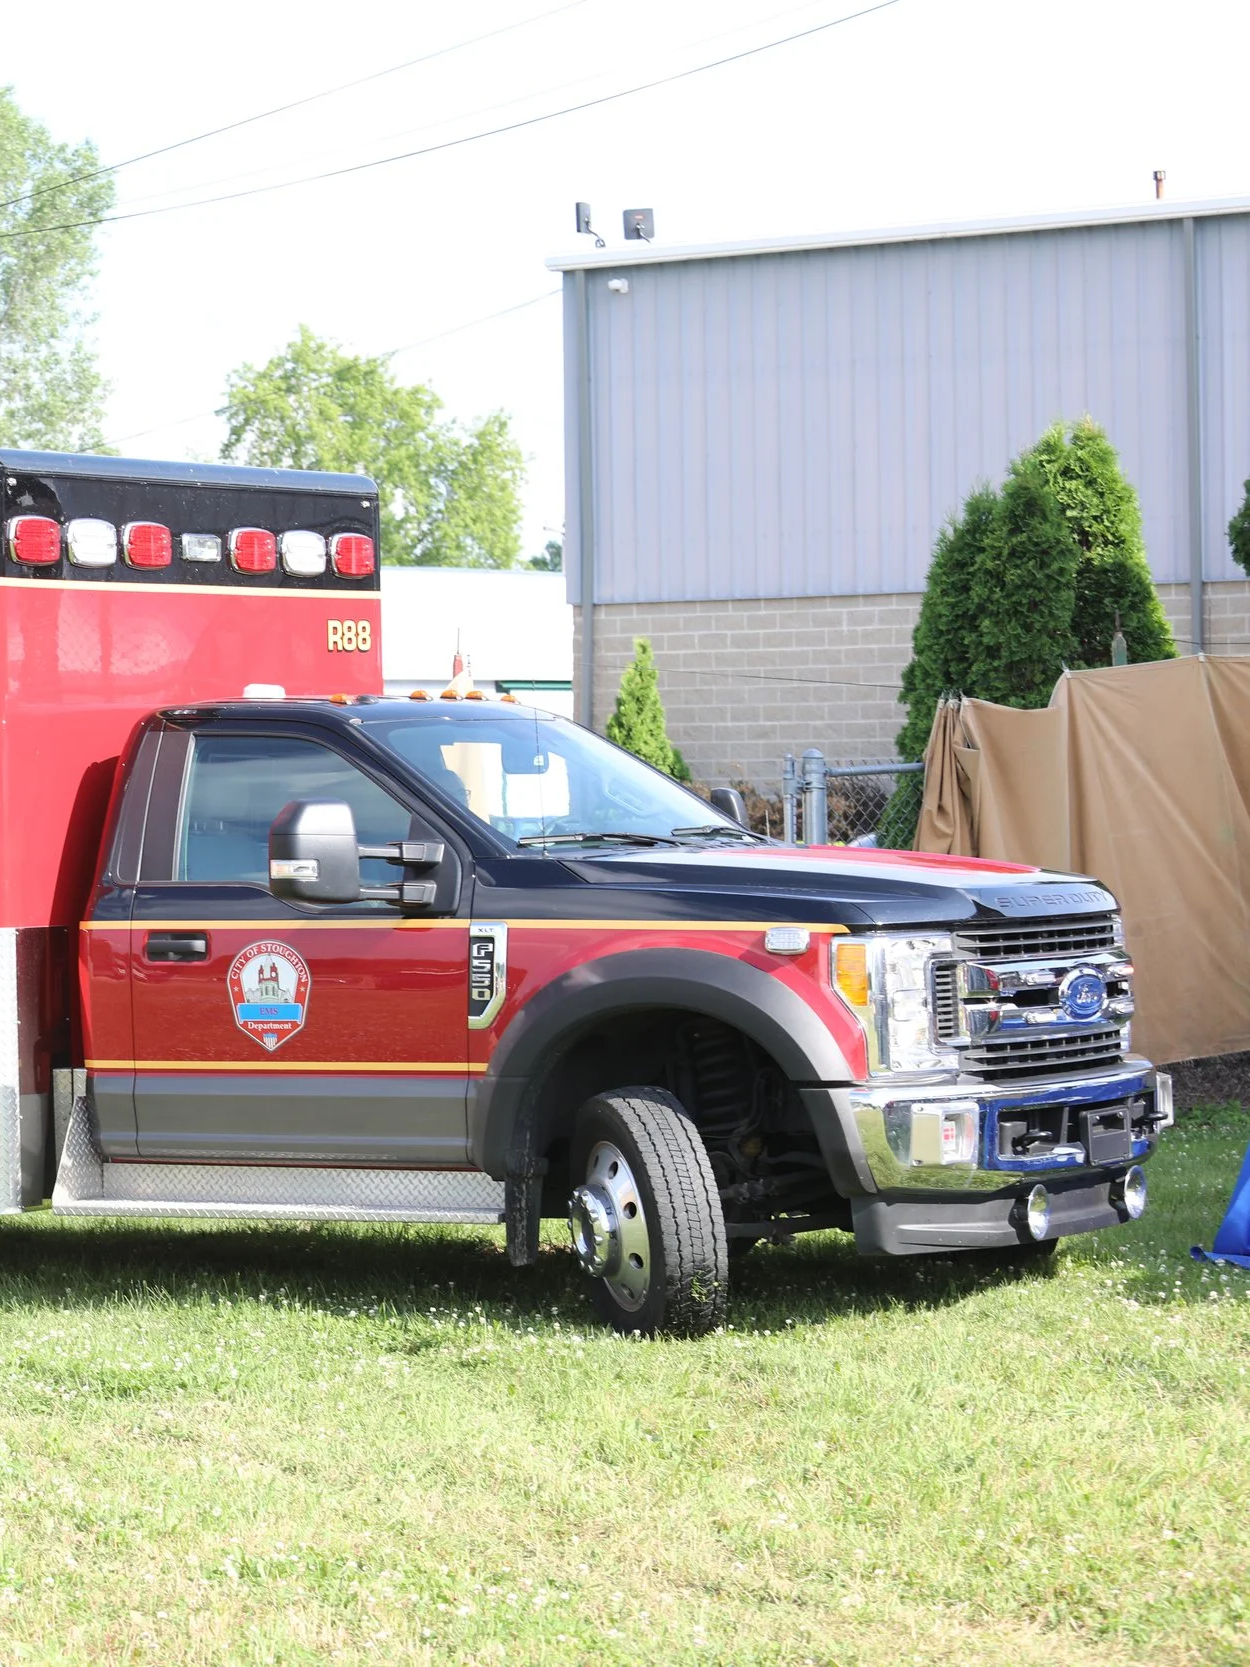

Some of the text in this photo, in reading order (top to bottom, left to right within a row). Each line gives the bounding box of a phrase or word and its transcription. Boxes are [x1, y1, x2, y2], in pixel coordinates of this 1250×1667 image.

[326, 618, 372, 653] R88
[231, 943, 308, 983] CITY OF STOUGHTON
[471, 942, 494, 1001] F550
[247, 1021, 292, 1032] Department
[259, 1007, 279, 1016] EMS
